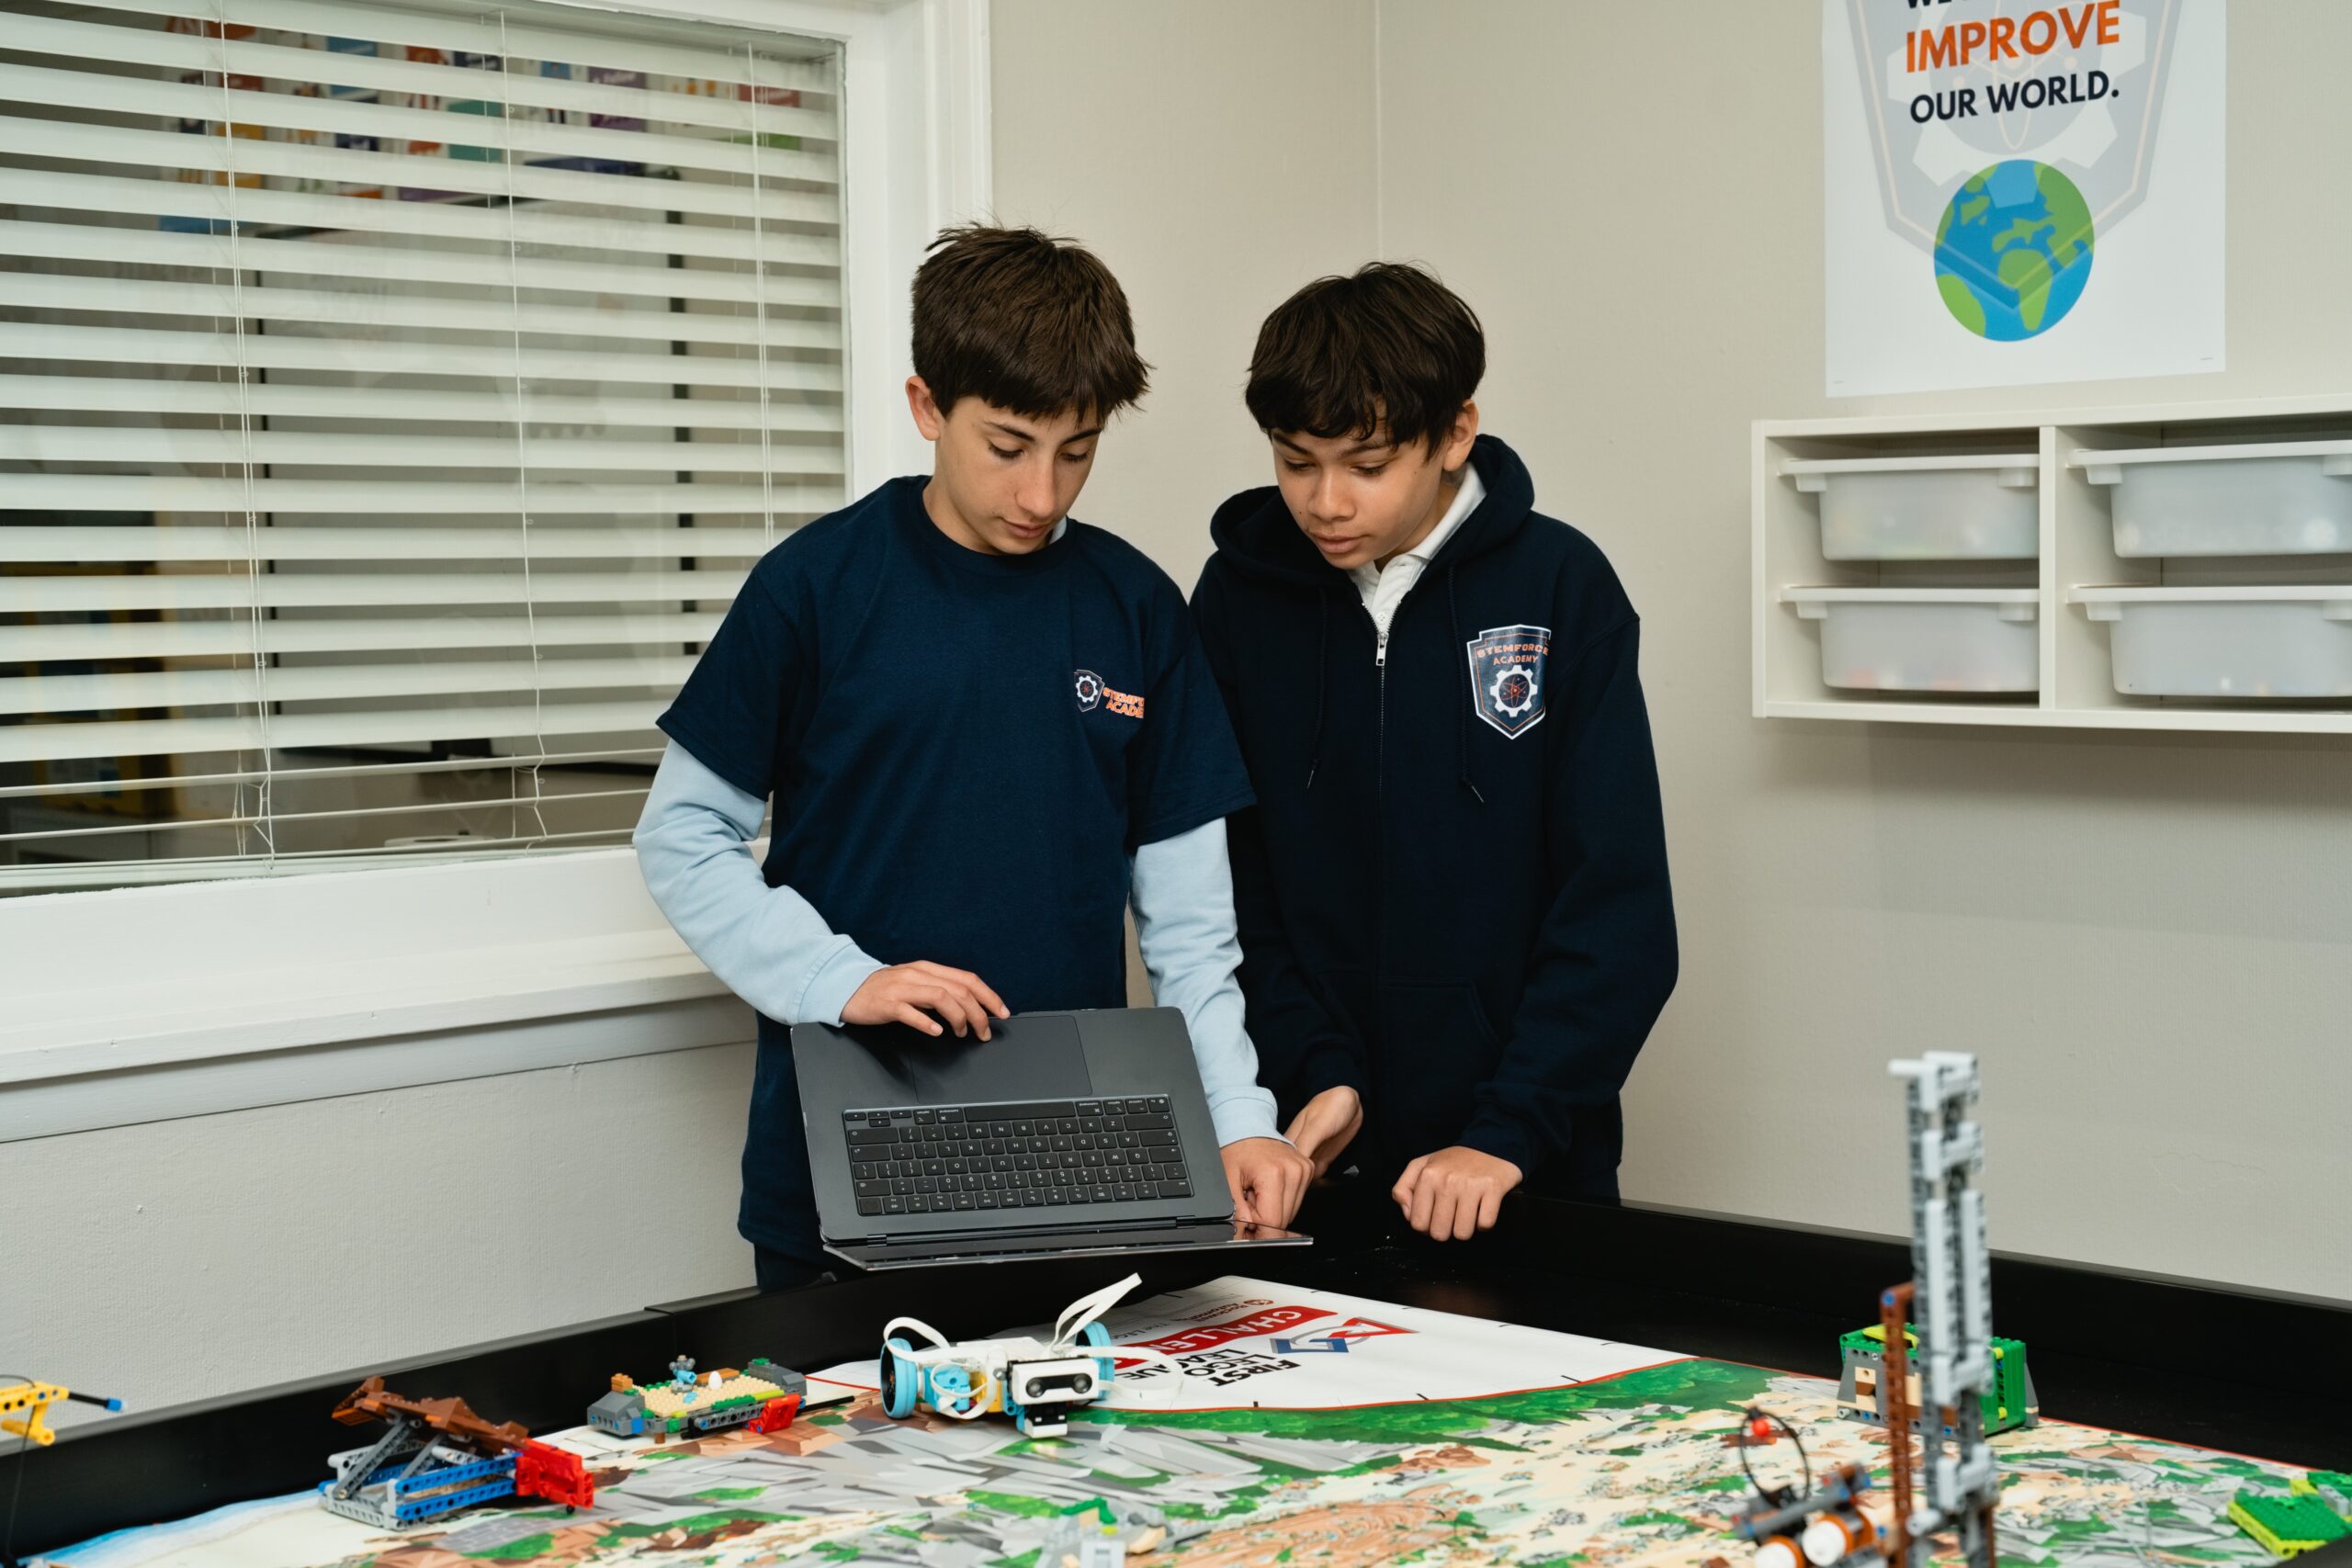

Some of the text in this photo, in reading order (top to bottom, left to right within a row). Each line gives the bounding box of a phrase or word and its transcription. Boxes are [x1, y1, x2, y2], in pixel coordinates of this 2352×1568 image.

[1906, 0, 2120, 73] IMPROVE
[1910, 70, 2120, 123] OUR WORLD.
[1476, 643, 1549, 659] STEMFORCE
[1493, 655, 1538, 665] ACADEMY
[1183, 1354, 1278, 1376] LEGO
[1208, 1359, 1301, 1386] FIRST
